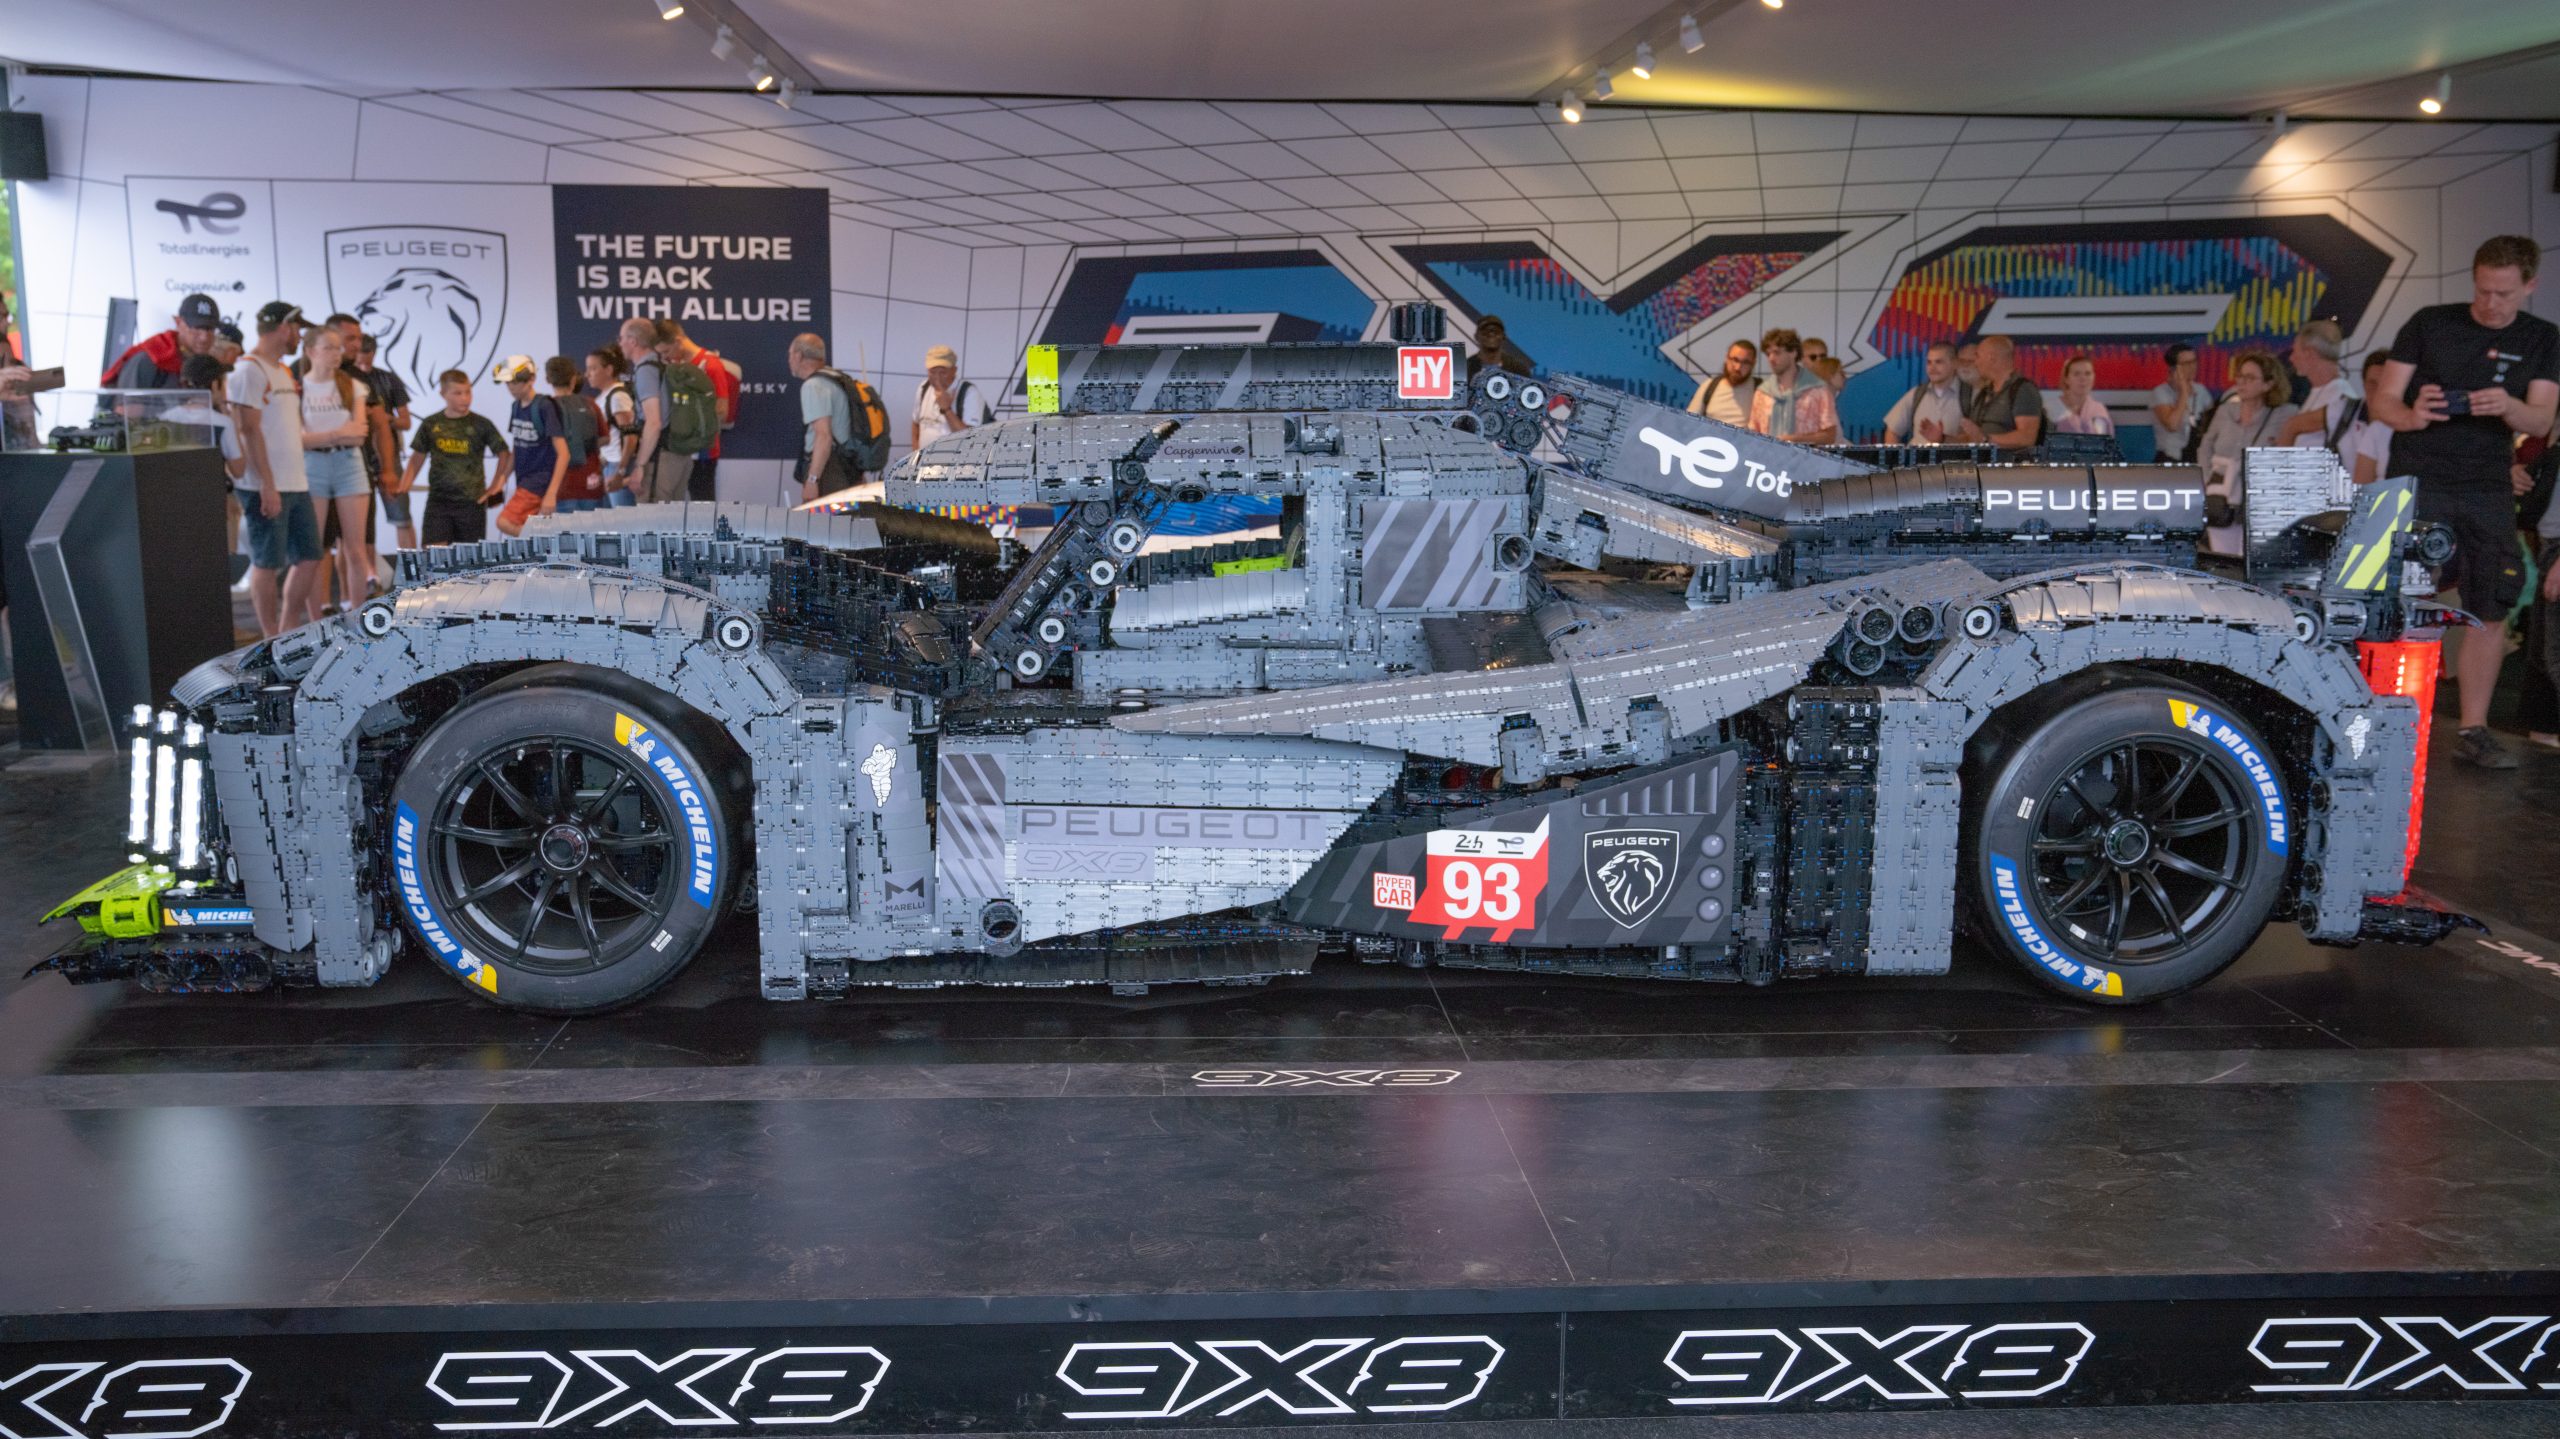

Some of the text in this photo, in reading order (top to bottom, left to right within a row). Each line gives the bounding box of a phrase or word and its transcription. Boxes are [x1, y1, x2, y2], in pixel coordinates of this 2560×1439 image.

[158, 242, 250, 258] TotalEnergies
[341, 240, 491, 260] PEUGEOT
[575, 233, 792, 260] THE FUTURE
[578, 264, 713, 290] IS BACK
[578, 296, 812, 321] WITH ALLURE
[1403, 356, 1448, 389] HY
[739, 383, 788, 394] MSKY
[1164, 446, 1230, 458] Capgemini
[1744, 460, 1792, 498] Tot
[1986, 489, 2201, 511] PEUGEOT
[2213, 724, 2286, 843] MICHELIN
[654, 755, 714, 894] MICHELIN
[1021, 808, 1321, 841] PEUGEOT
[1592, 837, 1671, 849] PEUGEOT
[1023, 850, 1148, 874] 9X8
[397, 816, 458, 954] MICHELIN
[1376, 876, 1412, 890] HYPER
[1442, 860, 1521, 921] 93
[885, 901, 925, 912] MARELLI
[1377, 887, 1412, 906] CAR
[197, 911, 255, 921] MICHEL
[1996, 867, 2079, 977] MICHELIN
[1192, 1070, 1461, 1086] 9X8
[1662, 1322, 2096, 1405] 9X8
[2247, 1316, 2560, 1392] 9X
[425, 1346, 892, 1431] 9X8
[1055, 1335, 1506, 1419] 9X8
